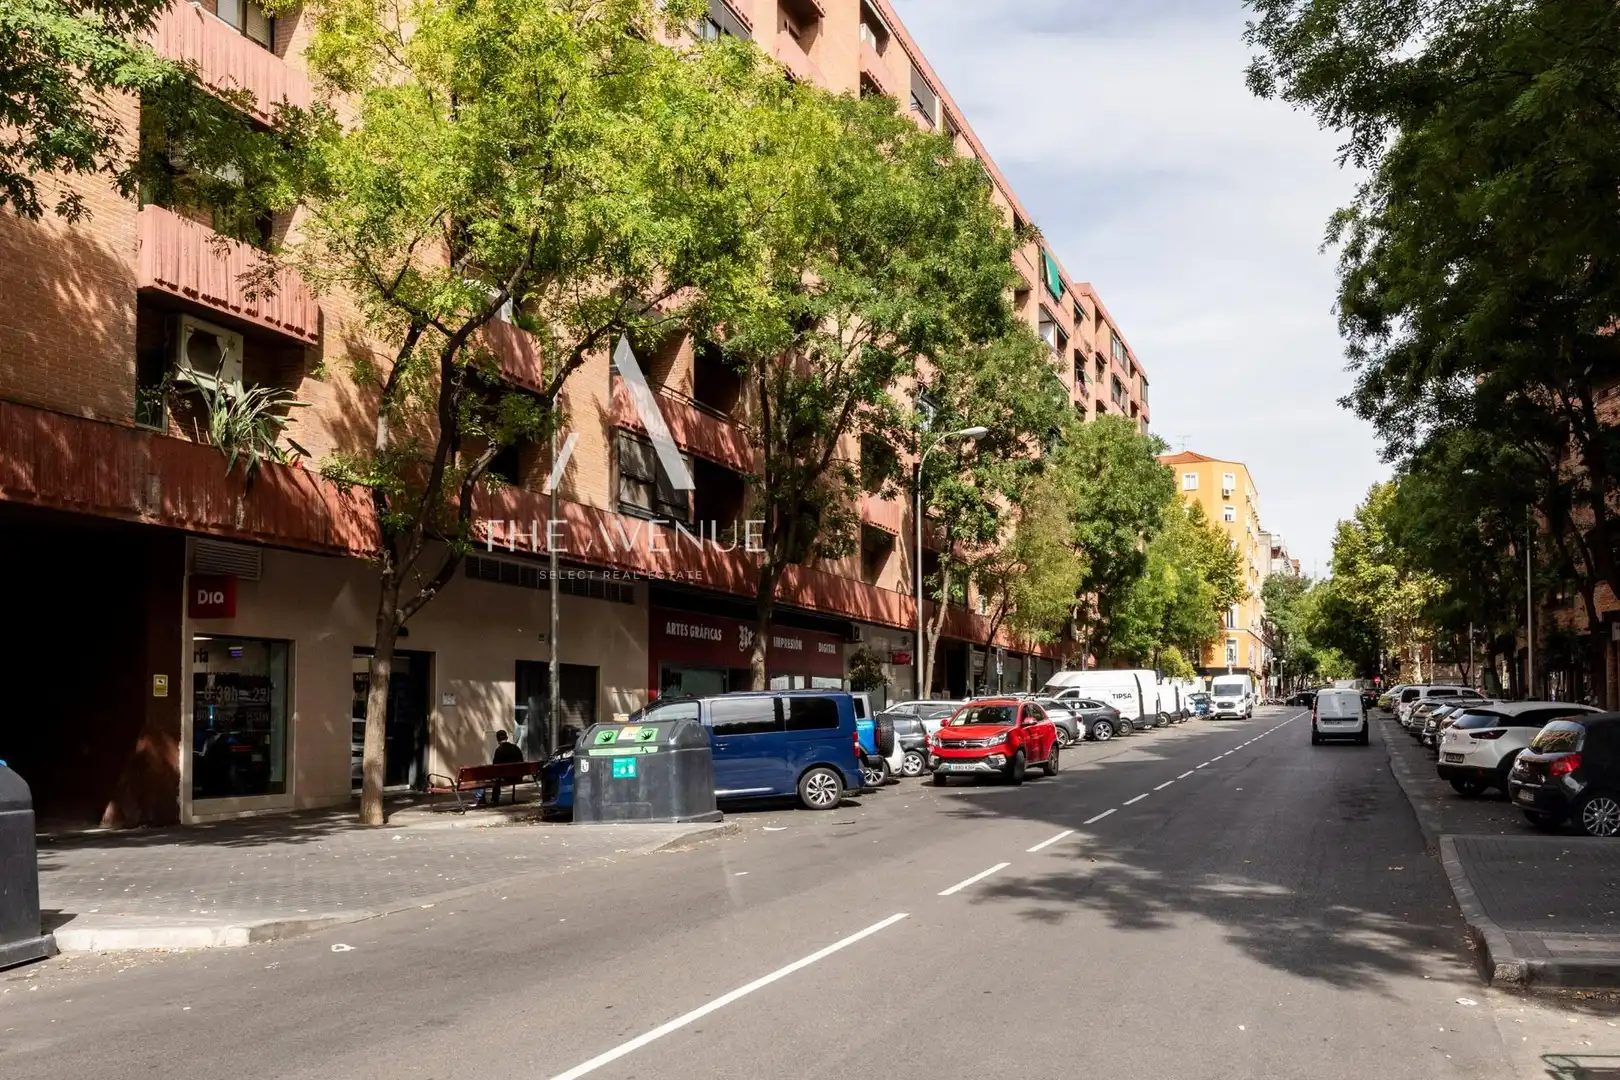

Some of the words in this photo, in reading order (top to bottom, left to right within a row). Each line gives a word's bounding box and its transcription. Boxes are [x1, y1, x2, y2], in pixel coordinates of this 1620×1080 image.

[666, 621, 688, 637] ARTES
[689, 624, 723, 641] GRÁFICAS
[773, 636, 803, 651] IMPRESIÓN
[818, 642, 836, 654] DIGITAL
[1111, 692, 1133, 700] TIPSA
